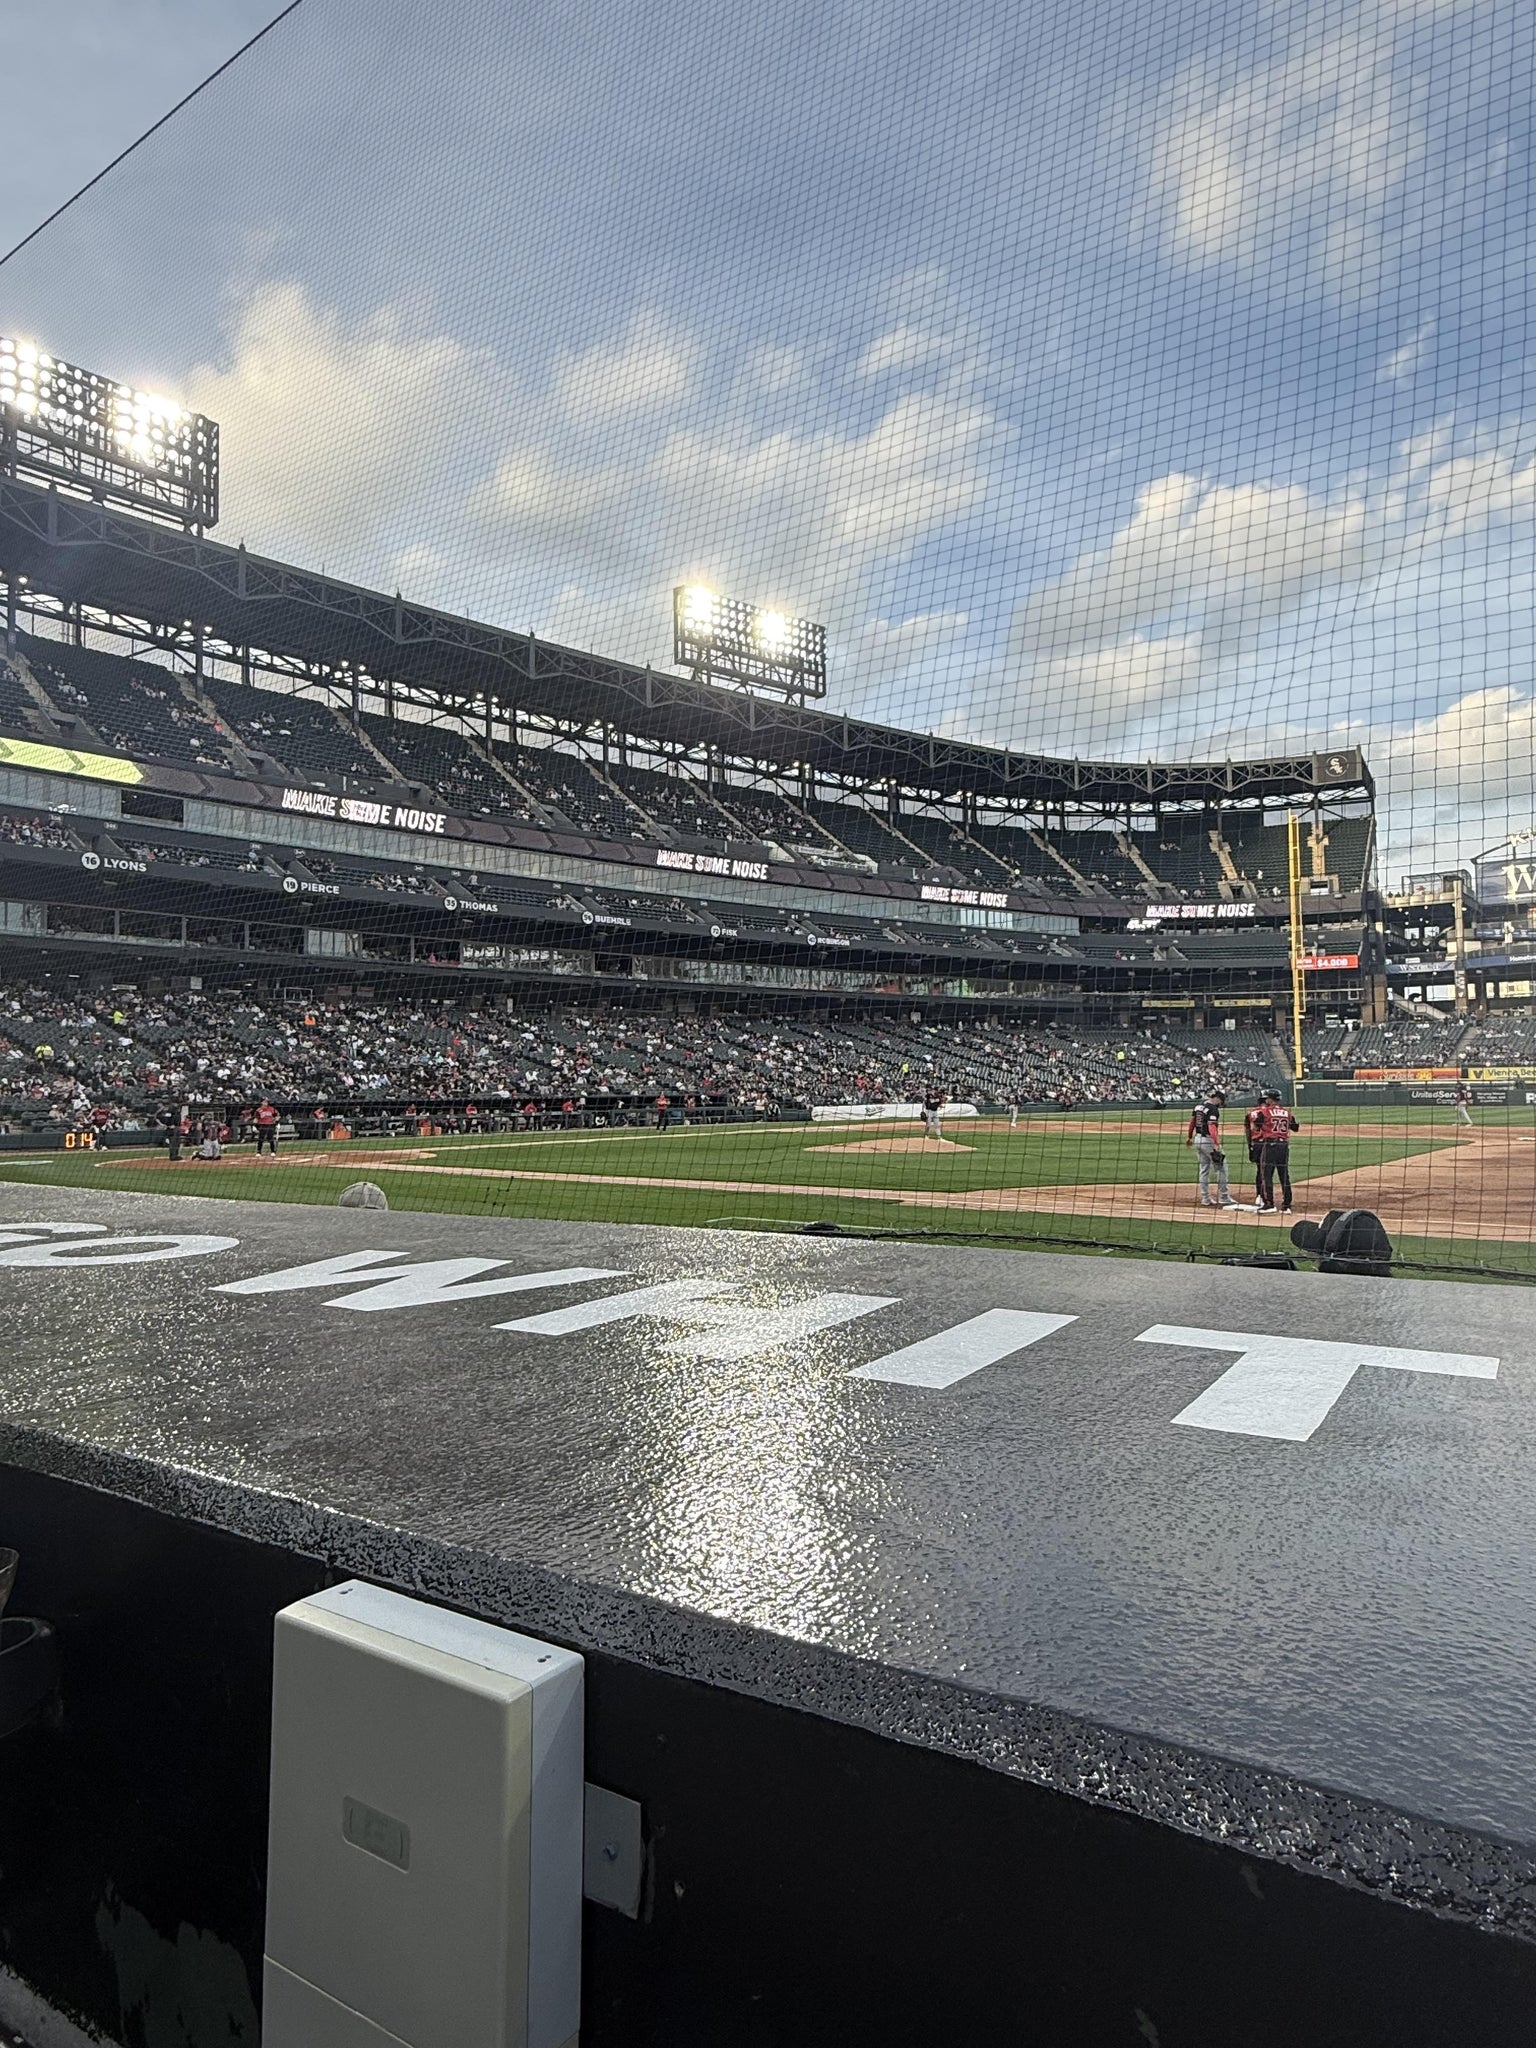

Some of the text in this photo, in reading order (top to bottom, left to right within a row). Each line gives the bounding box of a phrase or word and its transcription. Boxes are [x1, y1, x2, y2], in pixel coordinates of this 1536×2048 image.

[394, 807, 447, 833] NOISE
[103, 857, 147, 872] LYONS
[695, 854, 731, 875] SOME
[732, 860, 768, 880] NOISE
[300, 881, 340, 894] PIERCE
[459, 900, 498, 912] THOMAS
[979, 891, 1008, 907] NOISE
[1217, 903, 1256, 916] NOISE
[721, 928, 738, 937] FISK
[1487, 1068, 1519, 1077] Vienna
[1271, 1117, 1289, 1133] 73
